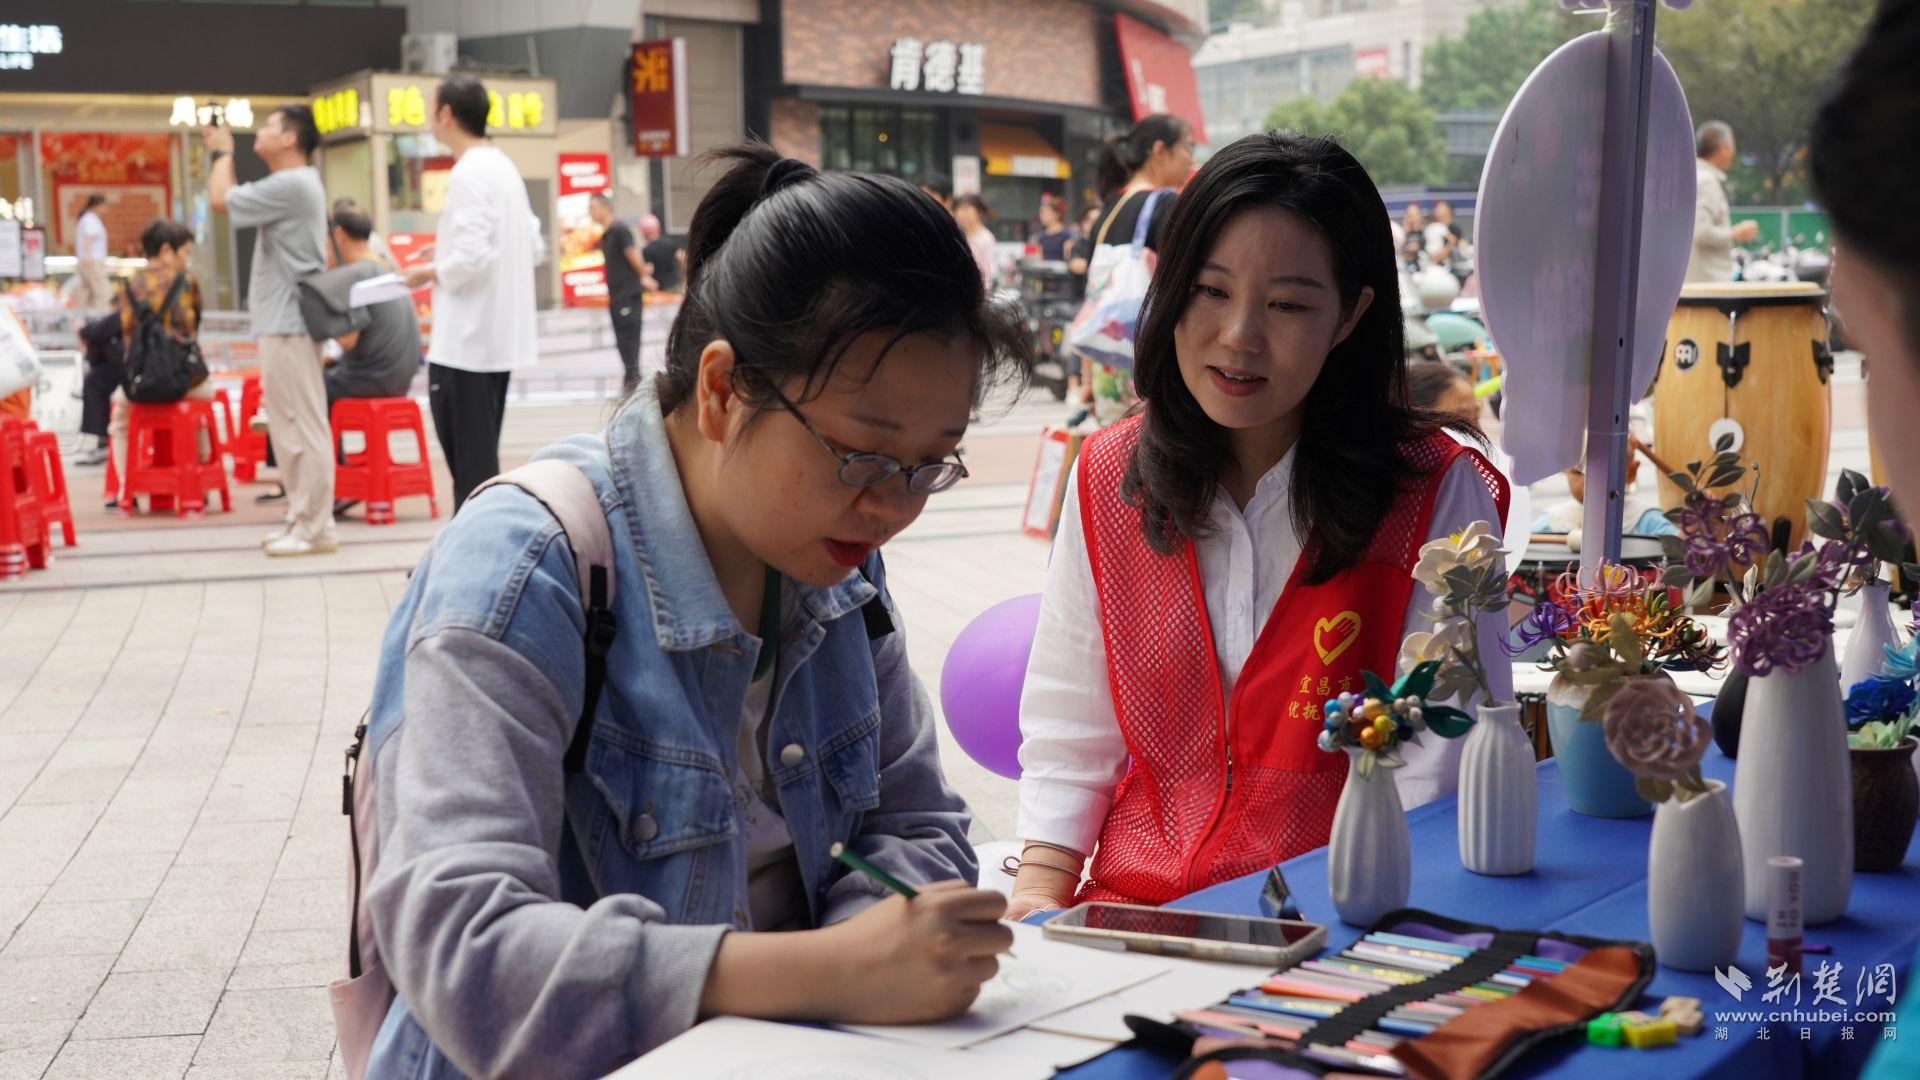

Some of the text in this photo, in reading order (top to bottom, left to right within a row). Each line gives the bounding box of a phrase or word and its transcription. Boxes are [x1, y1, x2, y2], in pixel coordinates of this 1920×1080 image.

[890, 37, 987, 95] 肯德基
[1299, 674, 1353, 697] 宜昌市
